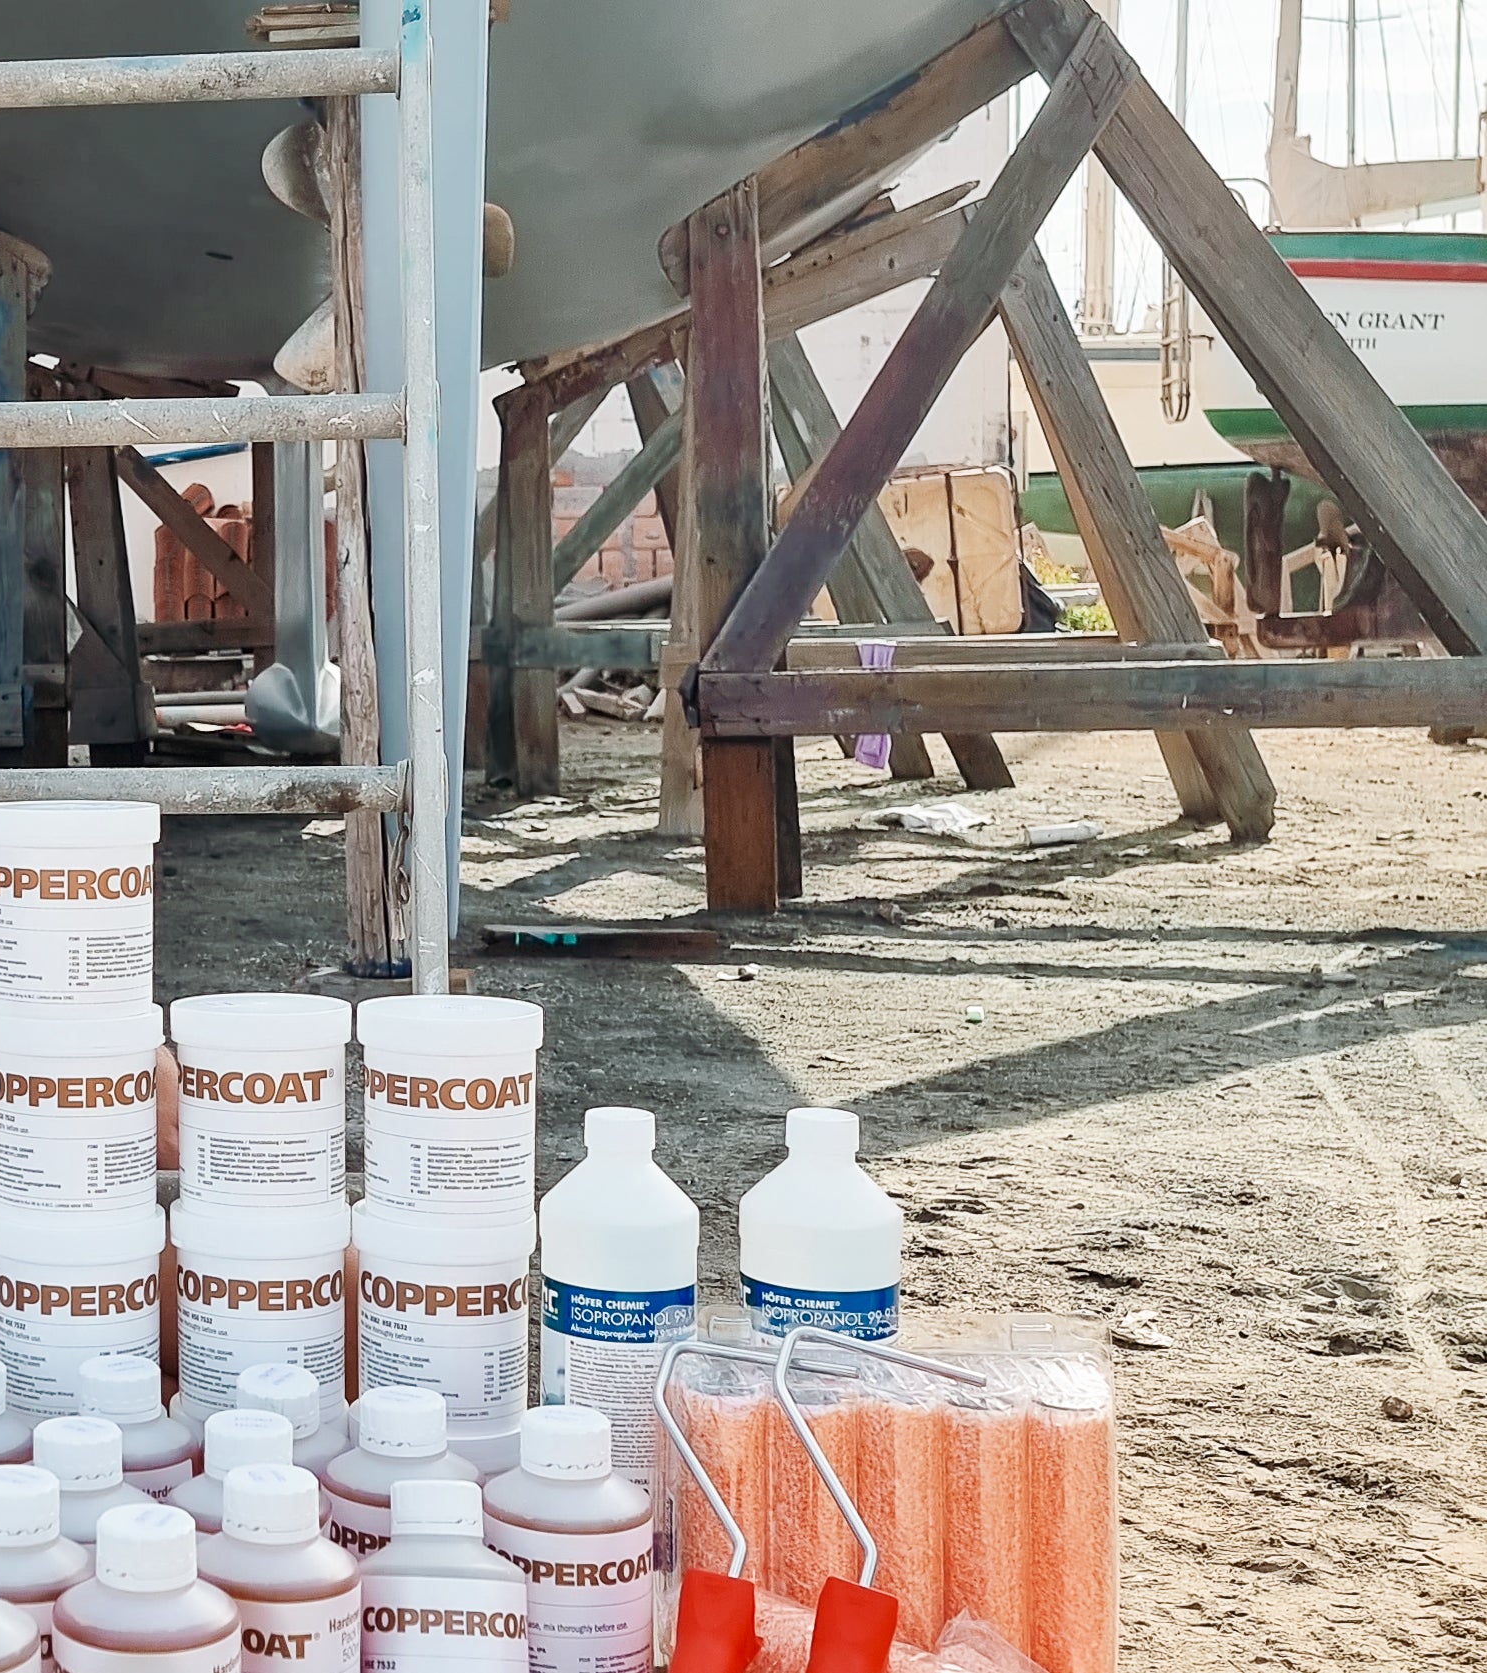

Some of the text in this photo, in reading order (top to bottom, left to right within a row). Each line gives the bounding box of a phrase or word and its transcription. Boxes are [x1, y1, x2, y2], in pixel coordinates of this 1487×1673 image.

[1358, 311, 1445, 330] GRANT
[570, 1293, 646, 1311] HÖFER CHEMIE
[761, 1290, 835, 1310] HÖFER CHEMIE
[570, 1305, 671, 1327] ISOPROPANOL
[761, 1303, 864, 1326] ISOPROPANOL
[557, 1624, 593, 1635] thoroughly
[594, 1623, 616, 1633] before
